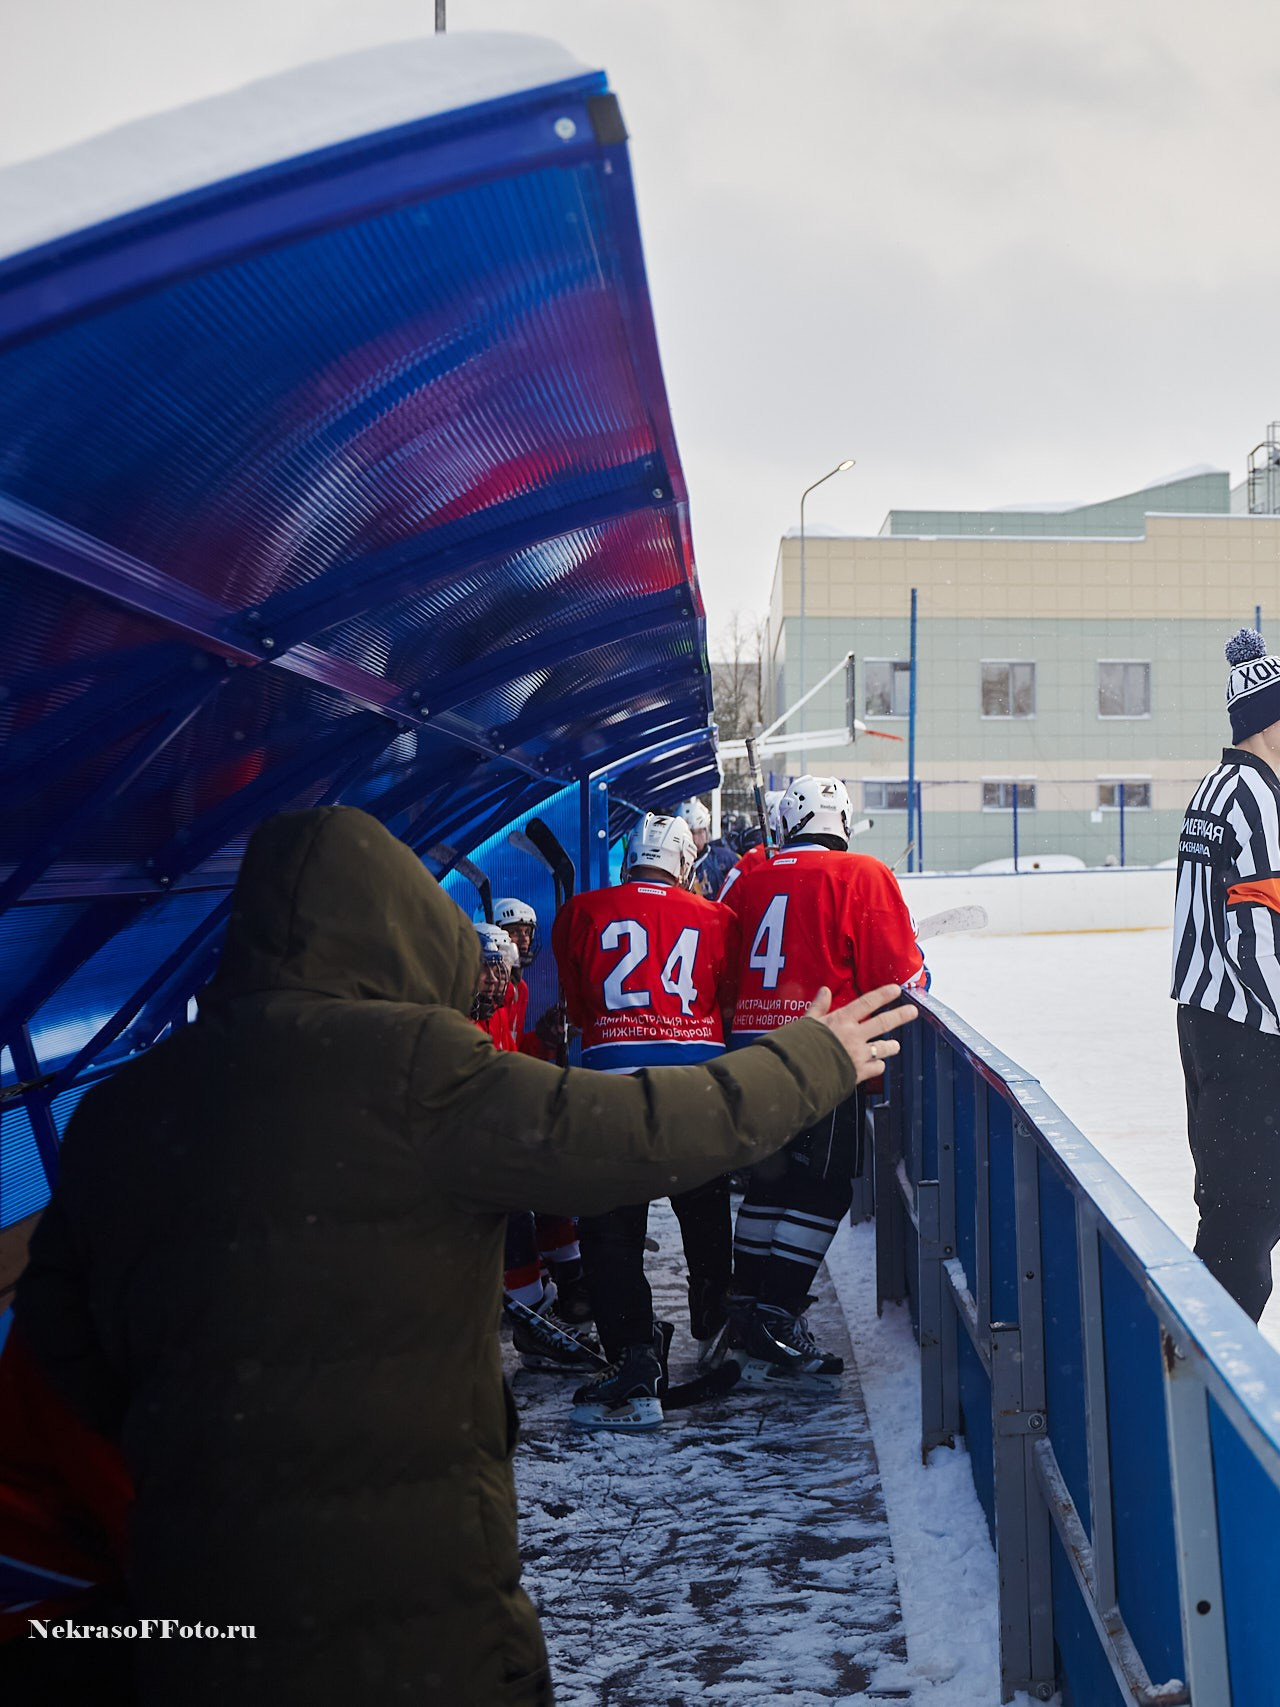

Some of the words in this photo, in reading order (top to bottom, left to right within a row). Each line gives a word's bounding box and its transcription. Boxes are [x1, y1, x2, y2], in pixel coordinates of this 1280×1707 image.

[601, 919, 700, 1016] 24
[749, 894, 789, 989] 4
[602, 1026, 657, 1039] НИЖНЕГО
